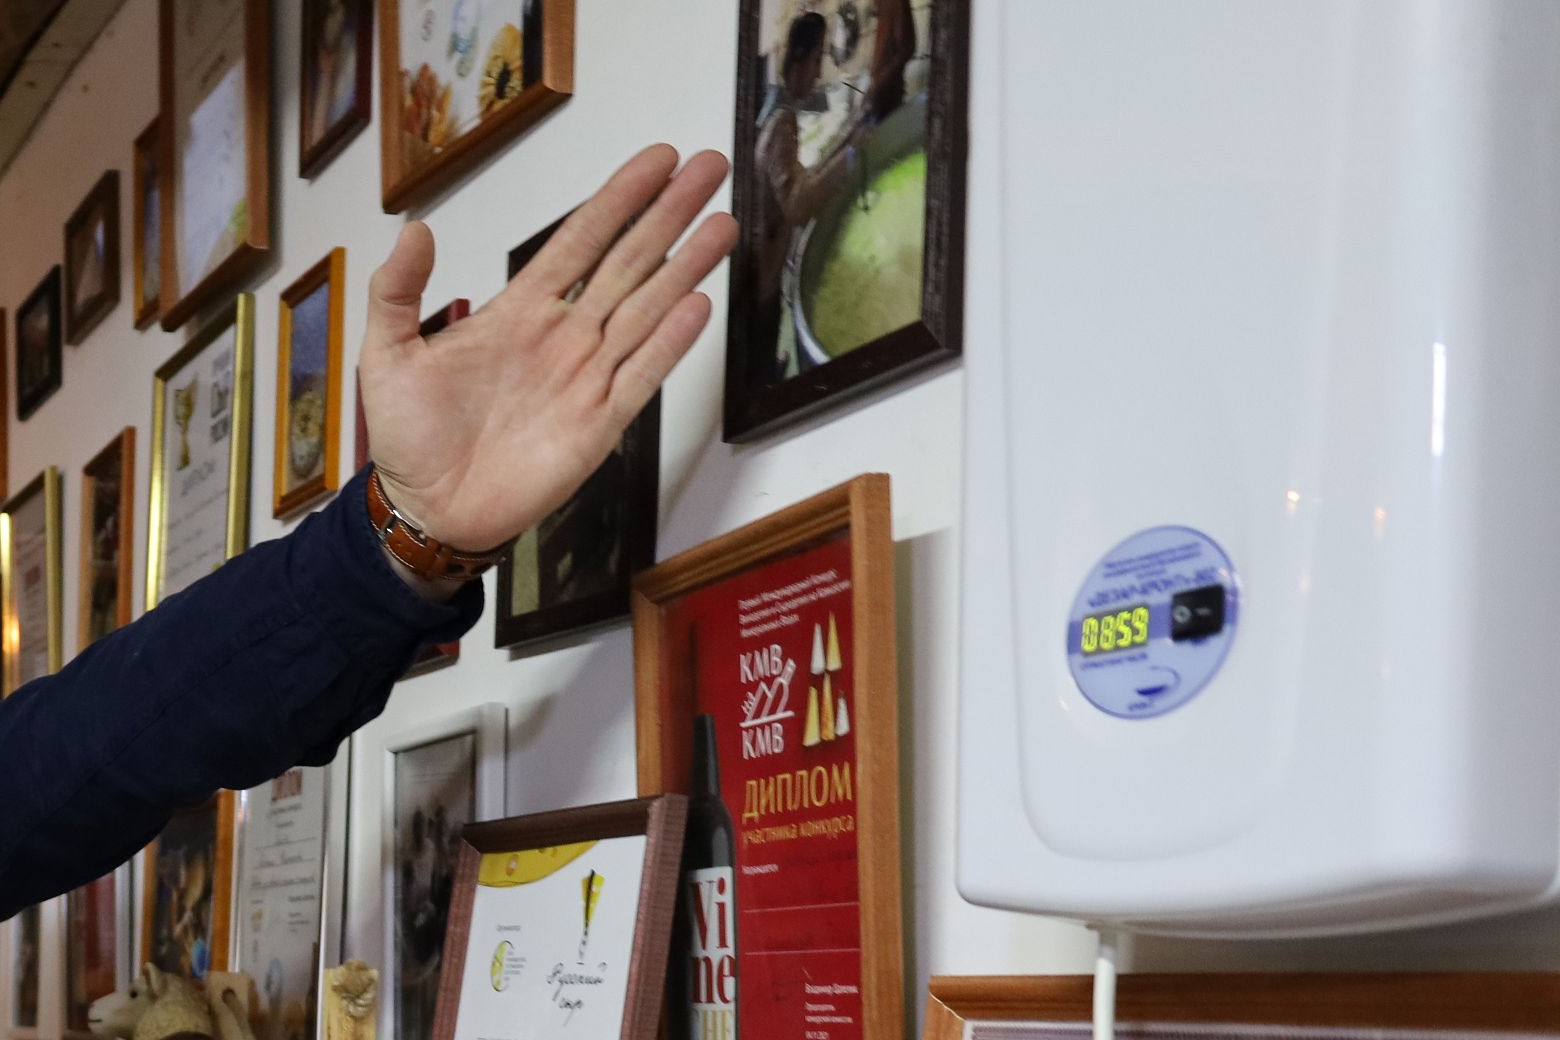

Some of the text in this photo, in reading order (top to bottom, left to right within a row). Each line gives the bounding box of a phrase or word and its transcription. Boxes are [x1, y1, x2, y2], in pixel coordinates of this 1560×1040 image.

[740, 644, 783, 684] КМВ
[742, 722, 785, 760] КМВ
[742, 761, 852, 825] ДИПЛОМ
